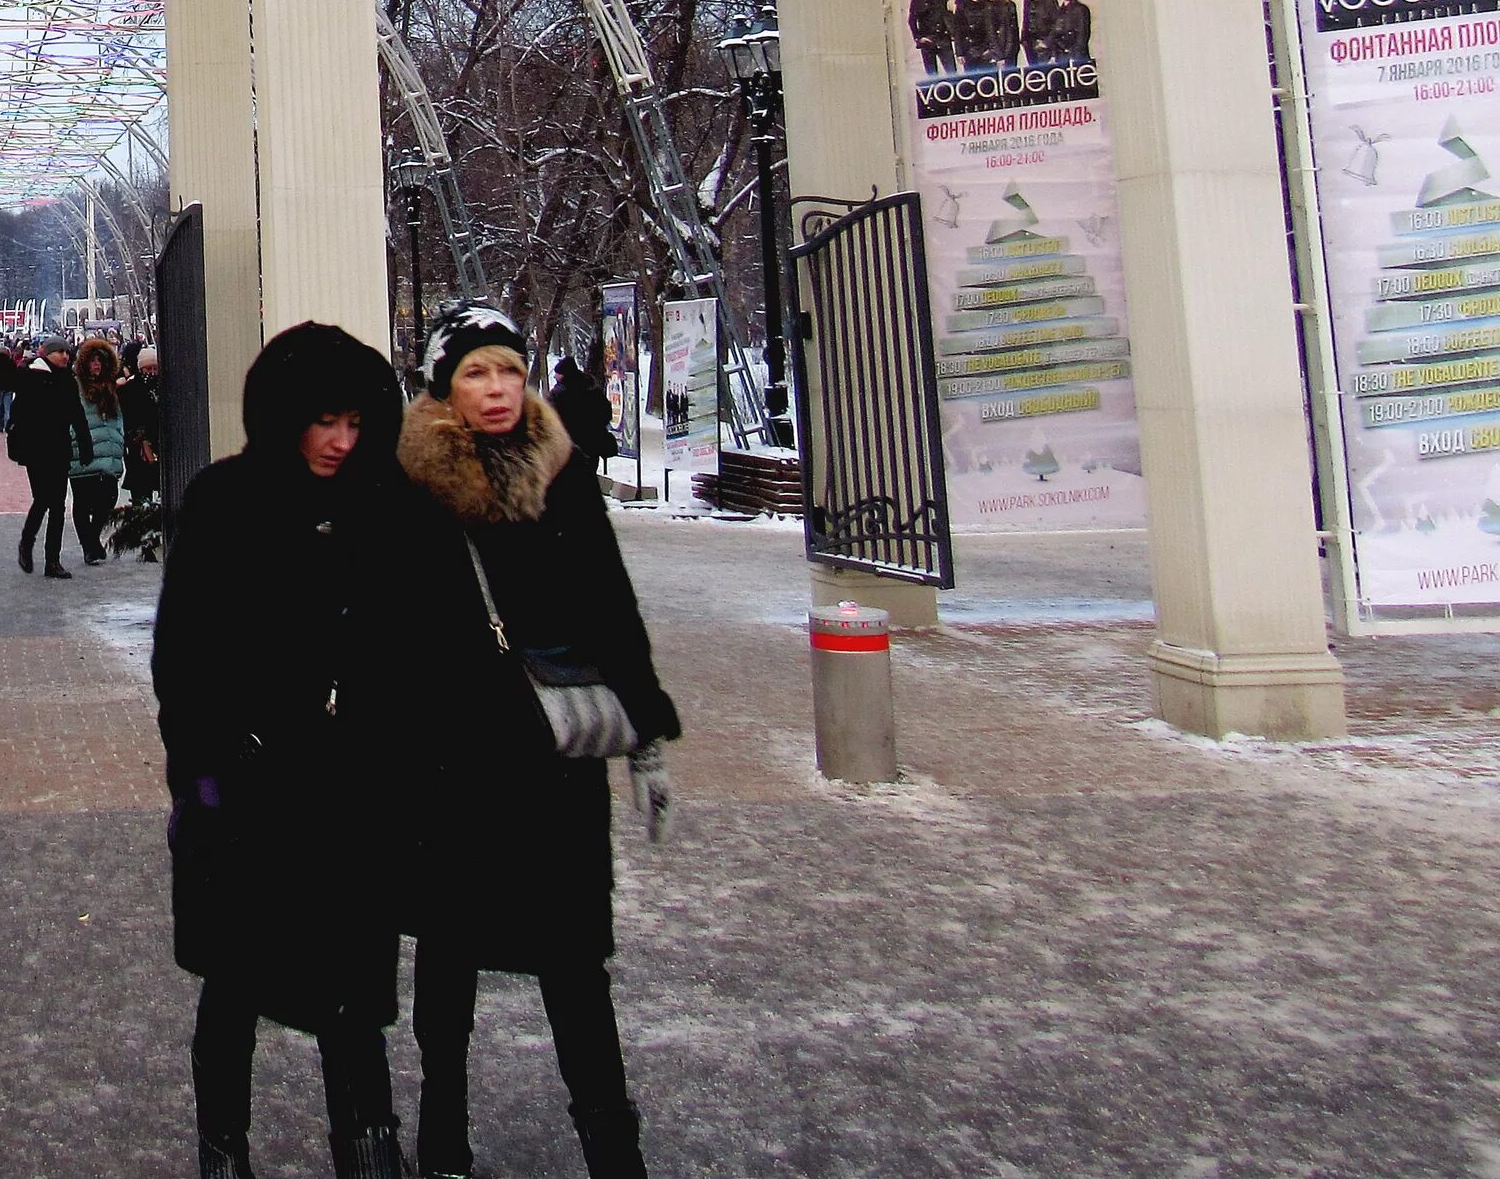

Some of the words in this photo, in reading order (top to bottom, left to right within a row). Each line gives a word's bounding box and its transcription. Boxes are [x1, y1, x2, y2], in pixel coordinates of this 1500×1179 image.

[1330, 26, 1452, 63] ФОНТАННАЯ
[1458, 20, 1500, 48] ПЛО
[1377, 66, 1385, 82] 7
[1389, 60, 1442, 81] ЯНВАРЯ
[1446, 55, 1480, 75] 2016
[917, 59, 1099, 106] vocaldente
[1413, 76, 1495, 101] 16:00-21:00
[926, 114, 1015, 141] ФОНТАННАЯ
[1019, 106, 1096, 131] ПЛОЩАДЬ.
[968, 137, 1008, 153] ЯНВАРЯ
[1009, 134, 1035, 150] 2016
[1036, 131, 1065, 147] ГОДА
[1354, 372, 1388, 393] 18:30
[1391, 369, 1414, 390] THE
[981, 400, 1015, 419] ВХОД
[1018, 389, 1098, 415] СВОБОДНЫЙ
[1369, 398, 1444, 422] 19:00-21:00
[1419, 430, 1465, 454] ВХОД
